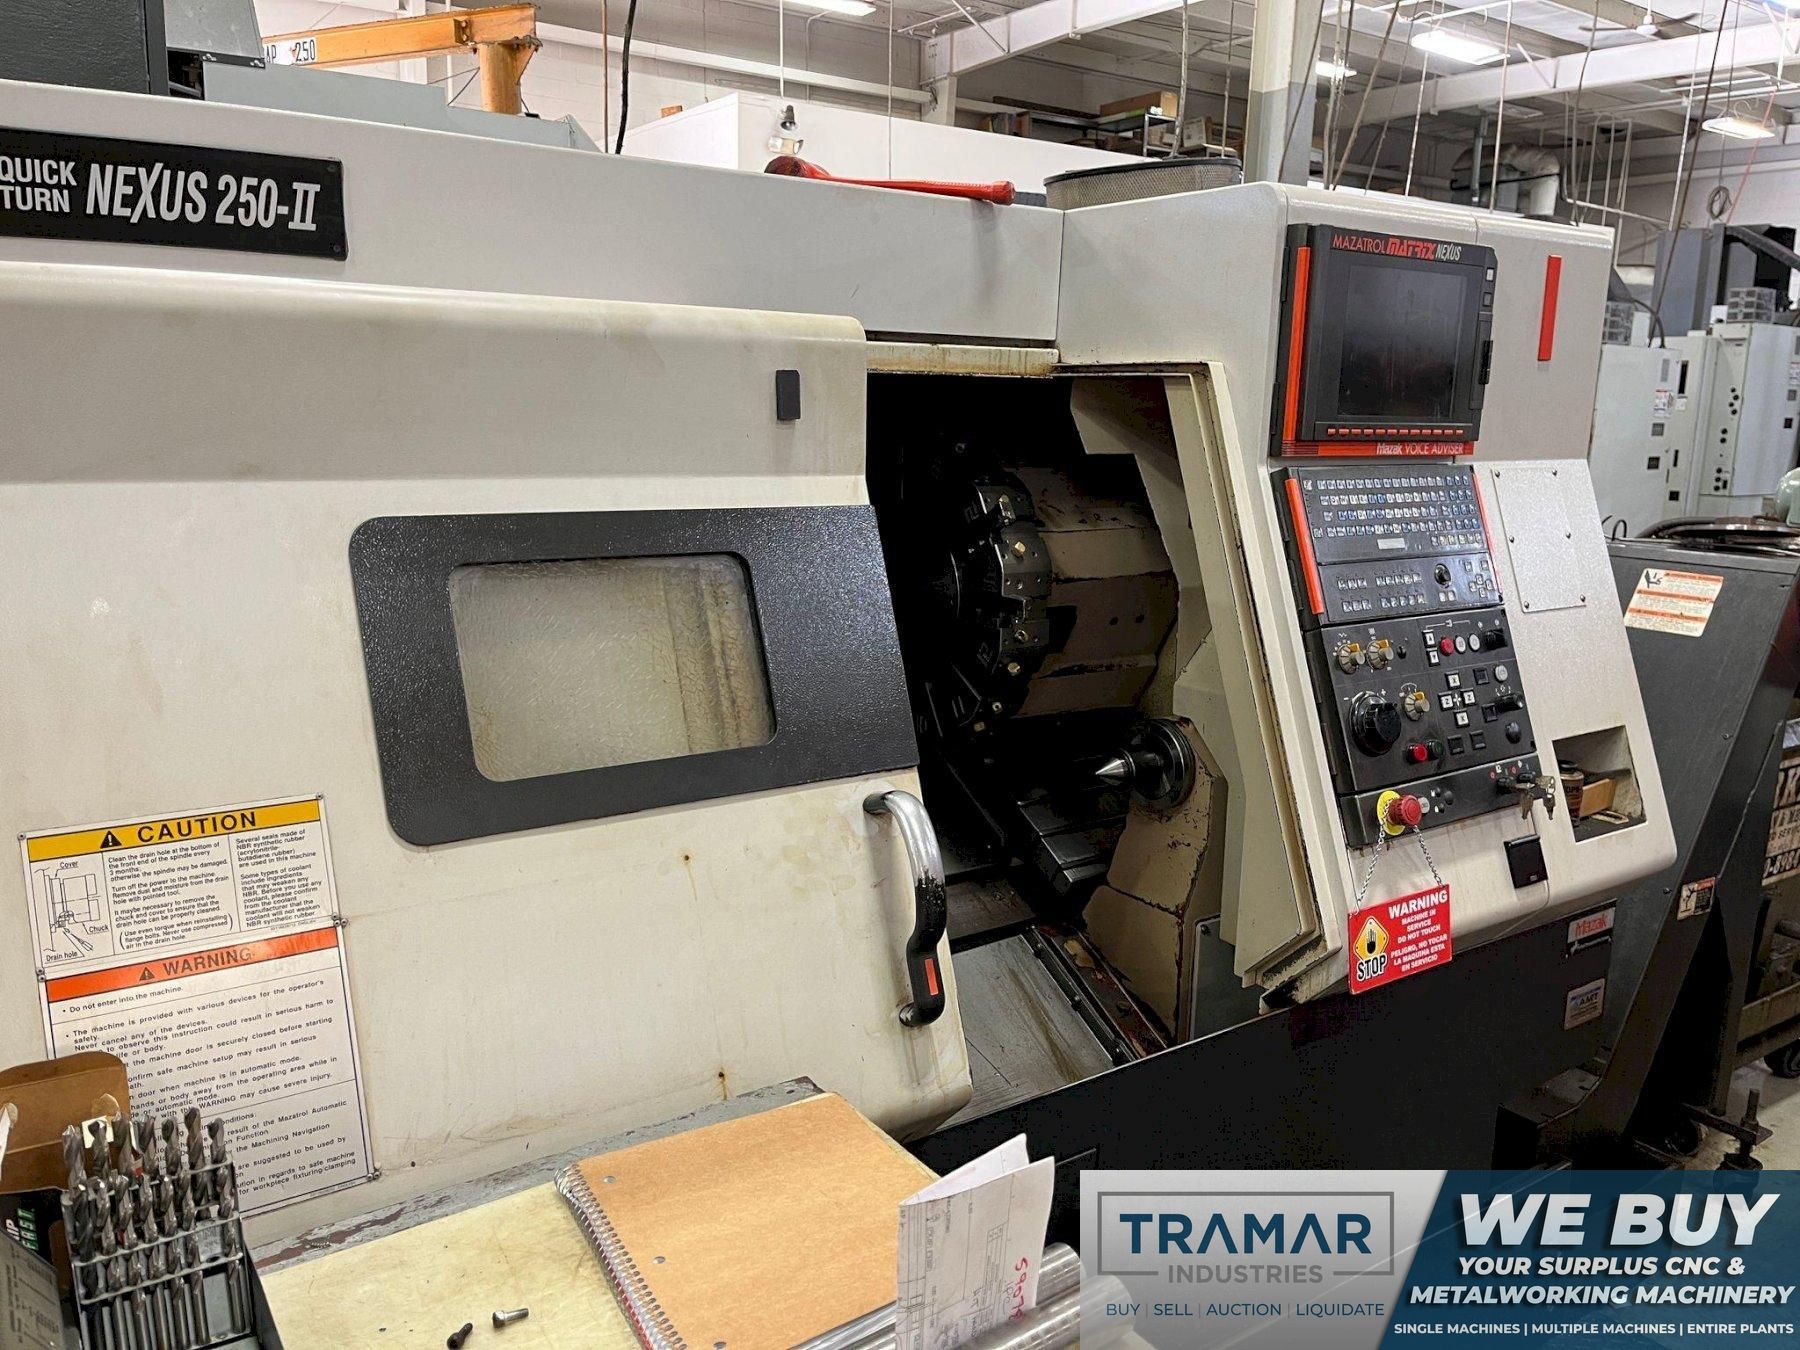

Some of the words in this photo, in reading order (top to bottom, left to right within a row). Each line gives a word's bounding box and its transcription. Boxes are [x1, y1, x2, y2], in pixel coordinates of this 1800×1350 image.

[295, 39, 316, 62] 250
[0, 156, 77, 186] QUICK
[0, 186, 70, 213] TURN
[85, 162, 208, 224] NEXUS
[215, 174, 320, 232] 250-II
[1333, 234, 1387, 252] MAZATROL
[1436, 243, 1462, 261] NEXUS
[1405, 442, 1430, 455] VOICE
[1432, 442, 1464, 454] ADVISER
[137, 812, 256, 842] CAUTION
[235, 835, 260, 844] Several
[190, 843, 212, 851] bottom
[60, 861, 78, 869] Cover
[1388, 890, 1448, 919] WARNING
[88, 924, 108, 934] Chuck
[1402, 912, 1428, 925] MACHINE
[1407, 919, 1432, 932] SERVICE
[1408, 930, 1420, 940] NOT
[1421, 924, 1441, 936] TOUCH
[46, 952, 62, 962] Drain
[64, 950, 78, 958] hole
[1390, 946, 1418, 958] PELIGRO,
[1418, 940, 1428, 948] NO
[1428, 934, 1448, 945] TOCAR
[1394, 958, 1402, 966] LA
[1402, 949, 1430, 962] MAQUINA
[162, 947, 251, 976] WARNING
[1357, 954, 1386, 980] STOP
[1402, 963, 1411, 972] EN
[1412, 954, 1438, 968] SERVICIO
[82, 1002, 95, 1010] not
[96, 999, 117, 1007] enter
[149, 986, 183, 996] machine.
[91, 1021, 124, 1033] machine
[139, 1010, 173, 1024] provided
[176, 1006, 193, 1015] with
[196, 1000, 225, 1011] various
[228, 994, 256, 1004] devices
[288, 980, 324, 992] operator's
[74, 1042, 97, 1051] Never
[101, 1035, 127, 1046] cancel
[176, 1019, 207, 1030] devices.
[118, 1038, 150, 1050] observe
[152, 1034, 168, 1042] this
[171, 1025, 213, 1038] instruction
[216, 1018, 237, 1029] could
[240, 1013, 262, 1023] result
[275, 1006, 302, 1016] serious
[304, 1000, 323, 1009] harm
[73, 1034, 99, 1044] safety.
[143, 1044, 165, 1053] body.
[148, 1051, 181, 1062] machine
[184, 1046, 202, 1055] door
[216, 1035, 248, 1047] securely
[251, 1028, 276, 1039] closed
[278, 1024, 302, 1033] before
[305, 1016, 332, 1027] starting
[127, 1072, 153, 1082] onfirm
[156, 1067, 173, 1076] safe
[176, 1059, 208, 1070] machine
[212, 1054, 233, 1063] setup
[255, 1043, 276, 1053] result
[290, 1034, 316, 1045] serious
[198, 1094, 236, 1109] WARNING
[258, 1085, 280, 1094] cause
[283, 1078, 307, 1088] severe
[310, 1072, 332, 1081] injury.
[226, 1125, 248, 1136] result
[277, 1109, 308, 1122] Mazatrol
[311, 1100, 346, 1114] Automatic
[250, 1134, 289, 1148] Machining
[291, 1123, 330, 1137] Navigation
[237, 1162, 250, 1170] are
[253, 1150, 291, 1166] suggested
[316, 1138, 334, 1148] used
